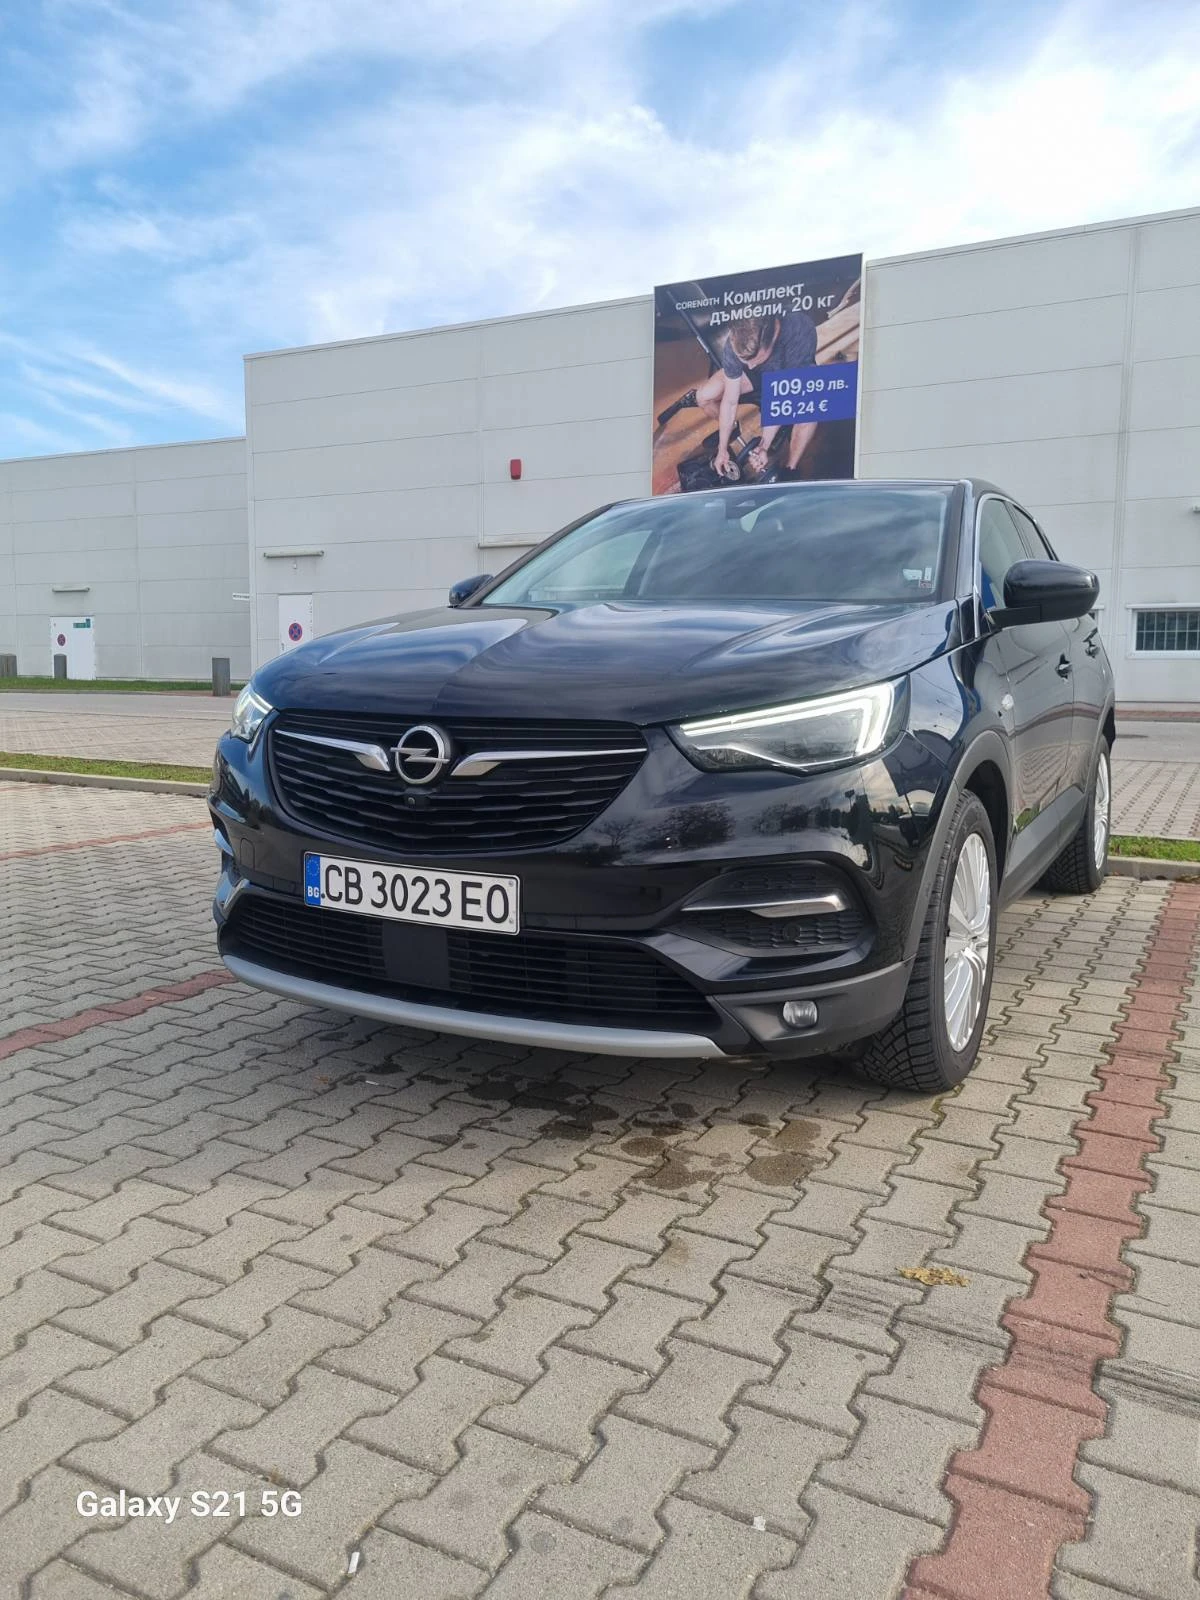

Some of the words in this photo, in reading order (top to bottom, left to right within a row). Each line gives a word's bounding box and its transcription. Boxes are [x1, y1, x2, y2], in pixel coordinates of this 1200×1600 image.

[723, 283, 804, 307] Комплект
[709, 303, 787, 326] дъмбели,
[791, 295, 813, 313] 20
[817, 295, 835, 308] кг
[770, 378, 824, 397] 109,99
[827, 379, 849, 391] лв.
[769, 399, 815, 418] 56,24
[818, 400, 828, 412] €
[307, 885, 320, 898] BG
[325, 864, 363, 905] CB
[370, 870, 452, 917] 3023
[461, 880, 509, 924] EO
